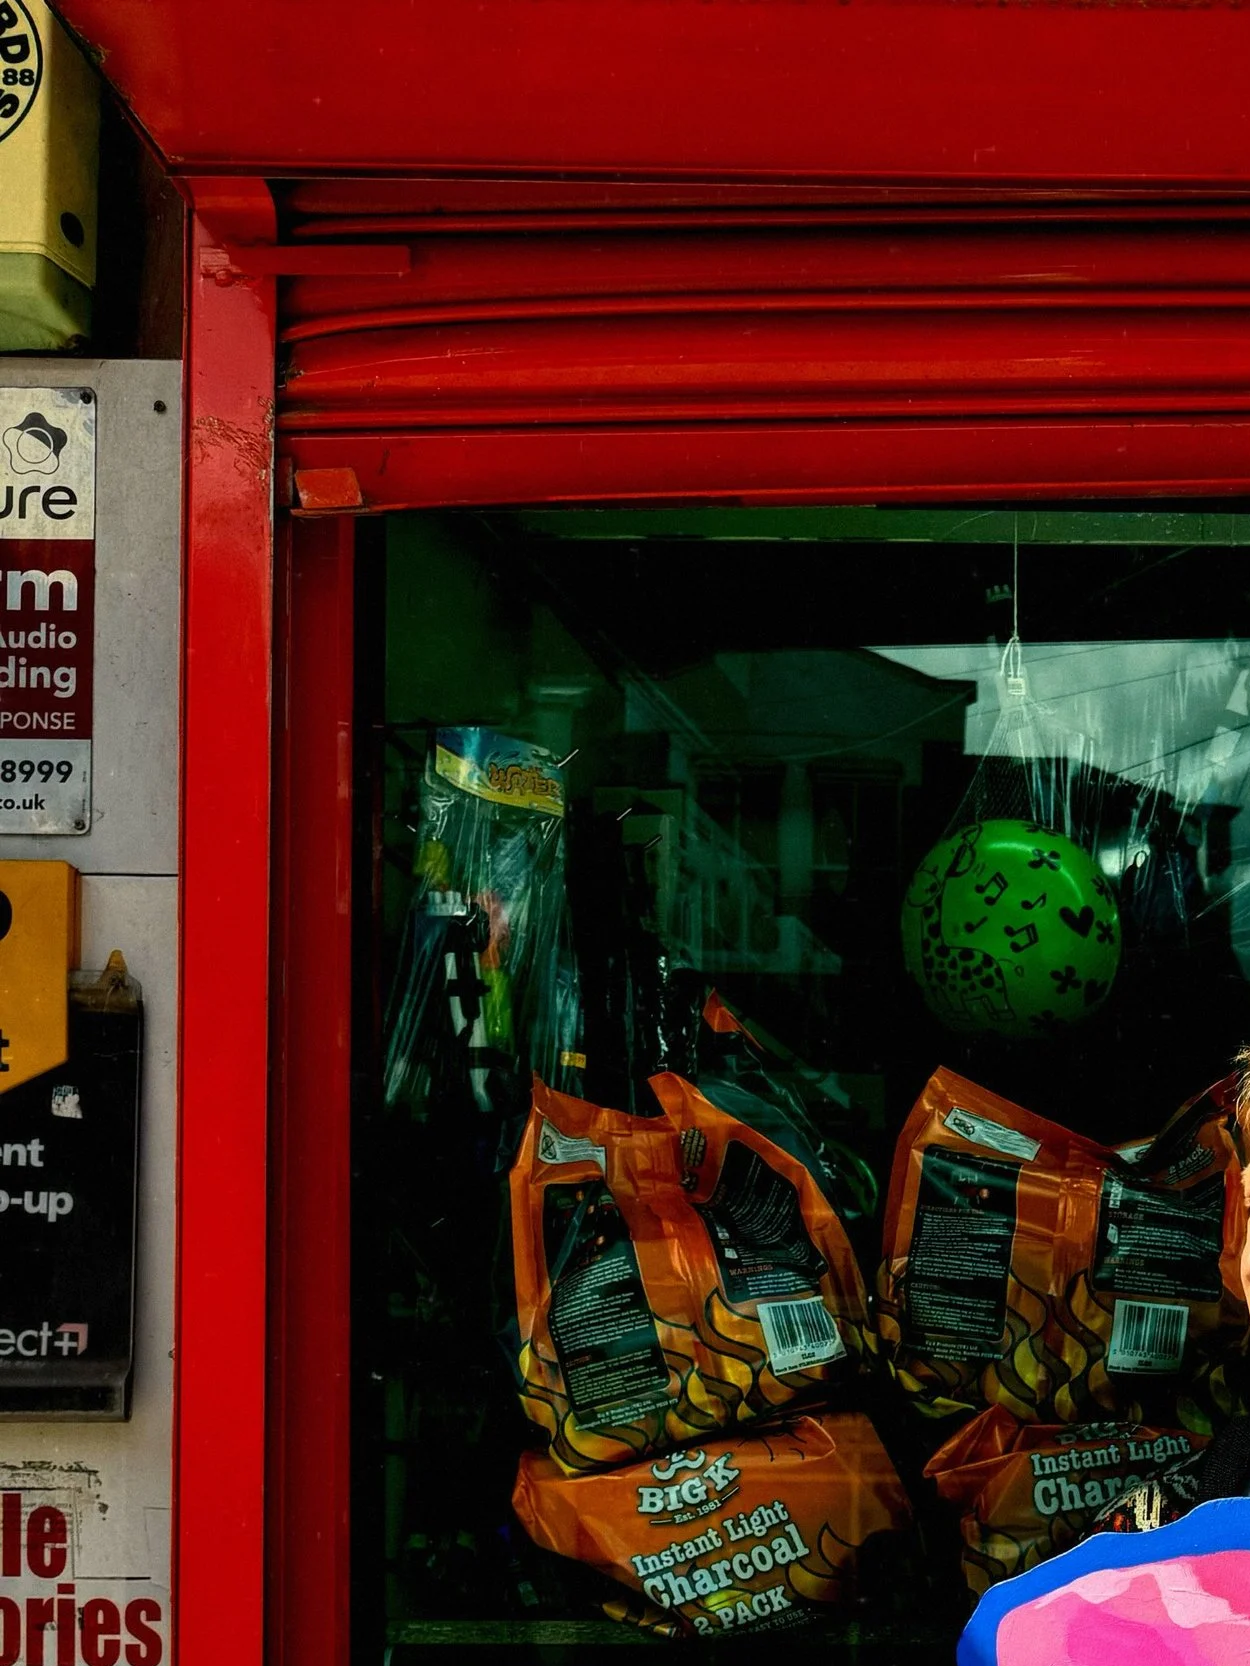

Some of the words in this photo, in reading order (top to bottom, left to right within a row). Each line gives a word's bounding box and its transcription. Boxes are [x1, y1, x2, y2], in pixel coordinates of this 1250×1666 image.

[2, 68, 35, 86] 88
[0, 570, 78, 611] m
[0, 622, 77, 649] udio
[0, 655, 77, 698] ding
[0, 712, 75, 729] PONSE
[0, 760, 73, 783] 8999
[0, 794, 45, 811] o.uk
[0, 1138, 44, 1167] nt
[1031, 1445, 1121, 1476] Instant
[1128, 1435, 1190, 1464] Light
[637, 1477, 706, 1516] BIG
[703, 1453, 742, 1493] K
[674, 1510, 697, 1525] Est.
[697, 1499, 722, 1518] 1981
[2, 1493, 68, 1580] le
[631, 1528, 723, 1577] Instant
[724, 1500, 789, 1541] Light
[643, 1523, 810, 1610] Charcoal
[693, 1616, 713, 1636] 2
[718, 1585, 792, 1632] PACK
